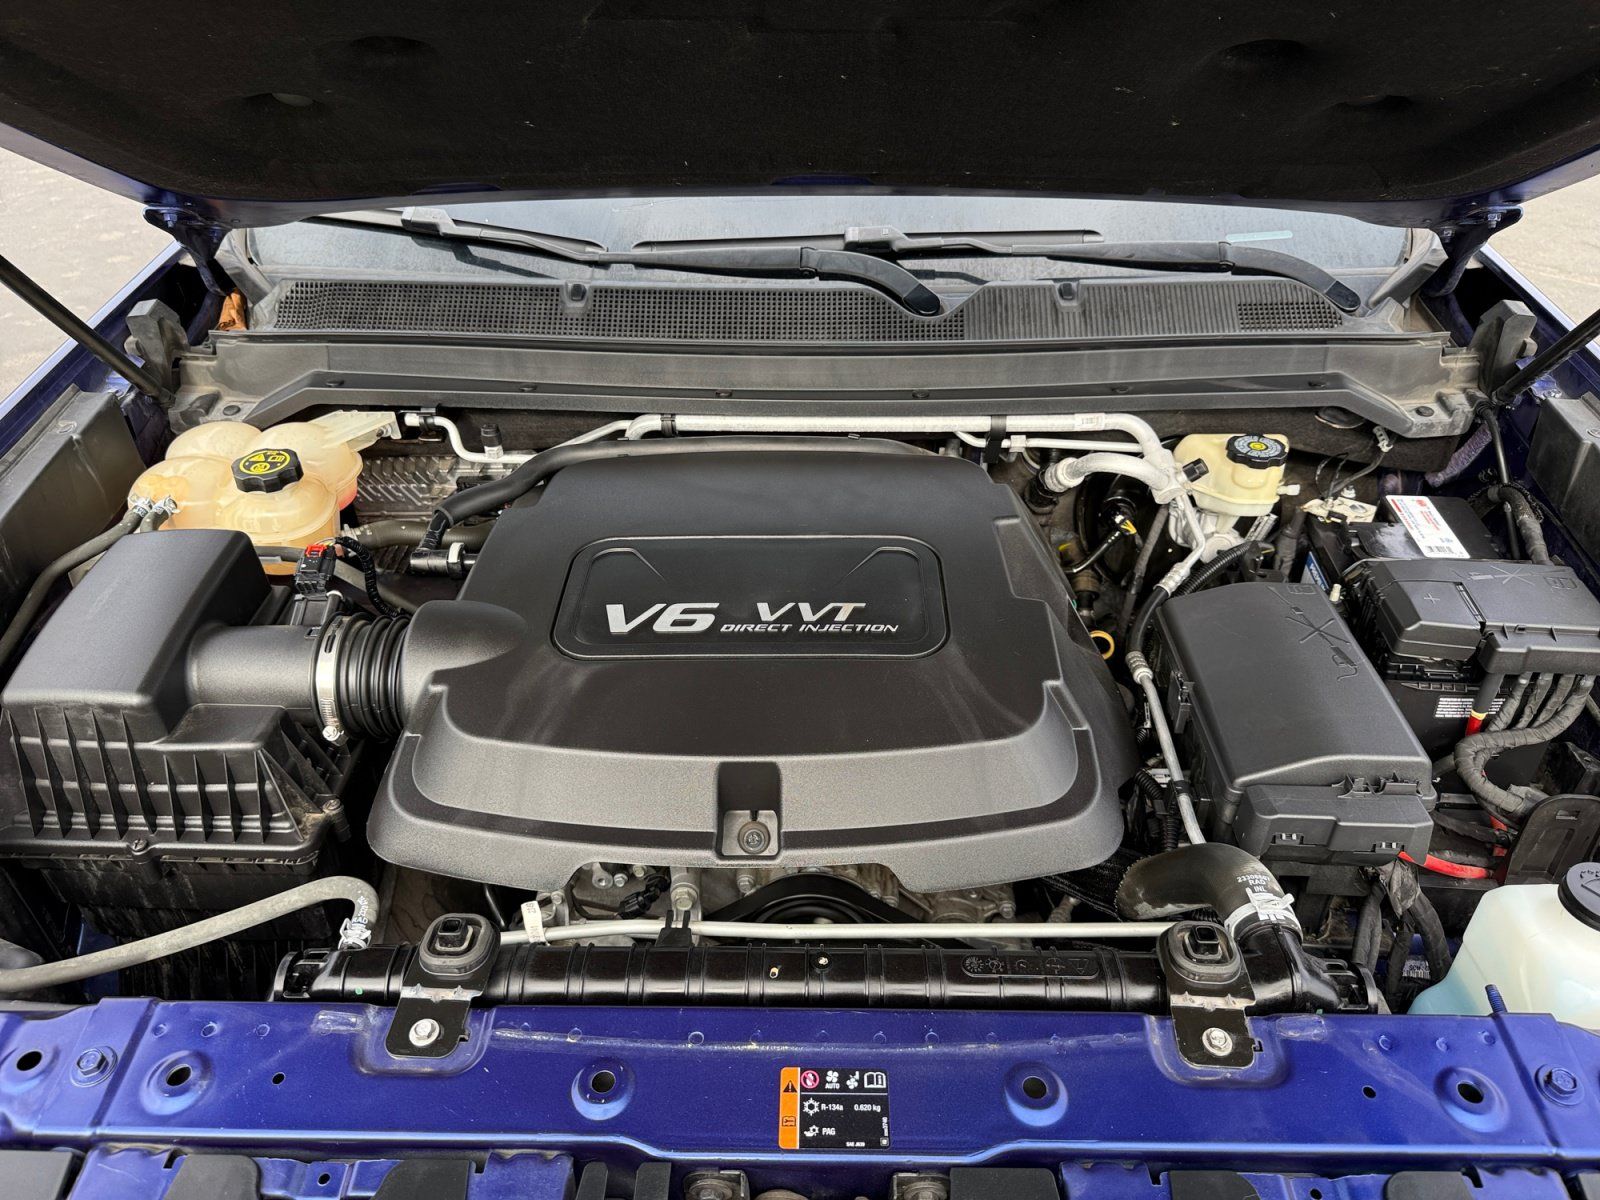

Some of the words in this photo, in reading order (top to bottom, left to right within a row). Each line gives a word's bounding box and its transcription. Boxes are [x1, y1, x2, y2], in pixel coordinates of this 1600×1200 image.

[606, 603, 720, 633] V6
[757, 602, 867, 621] VVT
[720, 623, 792, 633] DIRECT
[799, 623, 899, 633] INJECTION
[873, 1104, 881, 1112] kg
